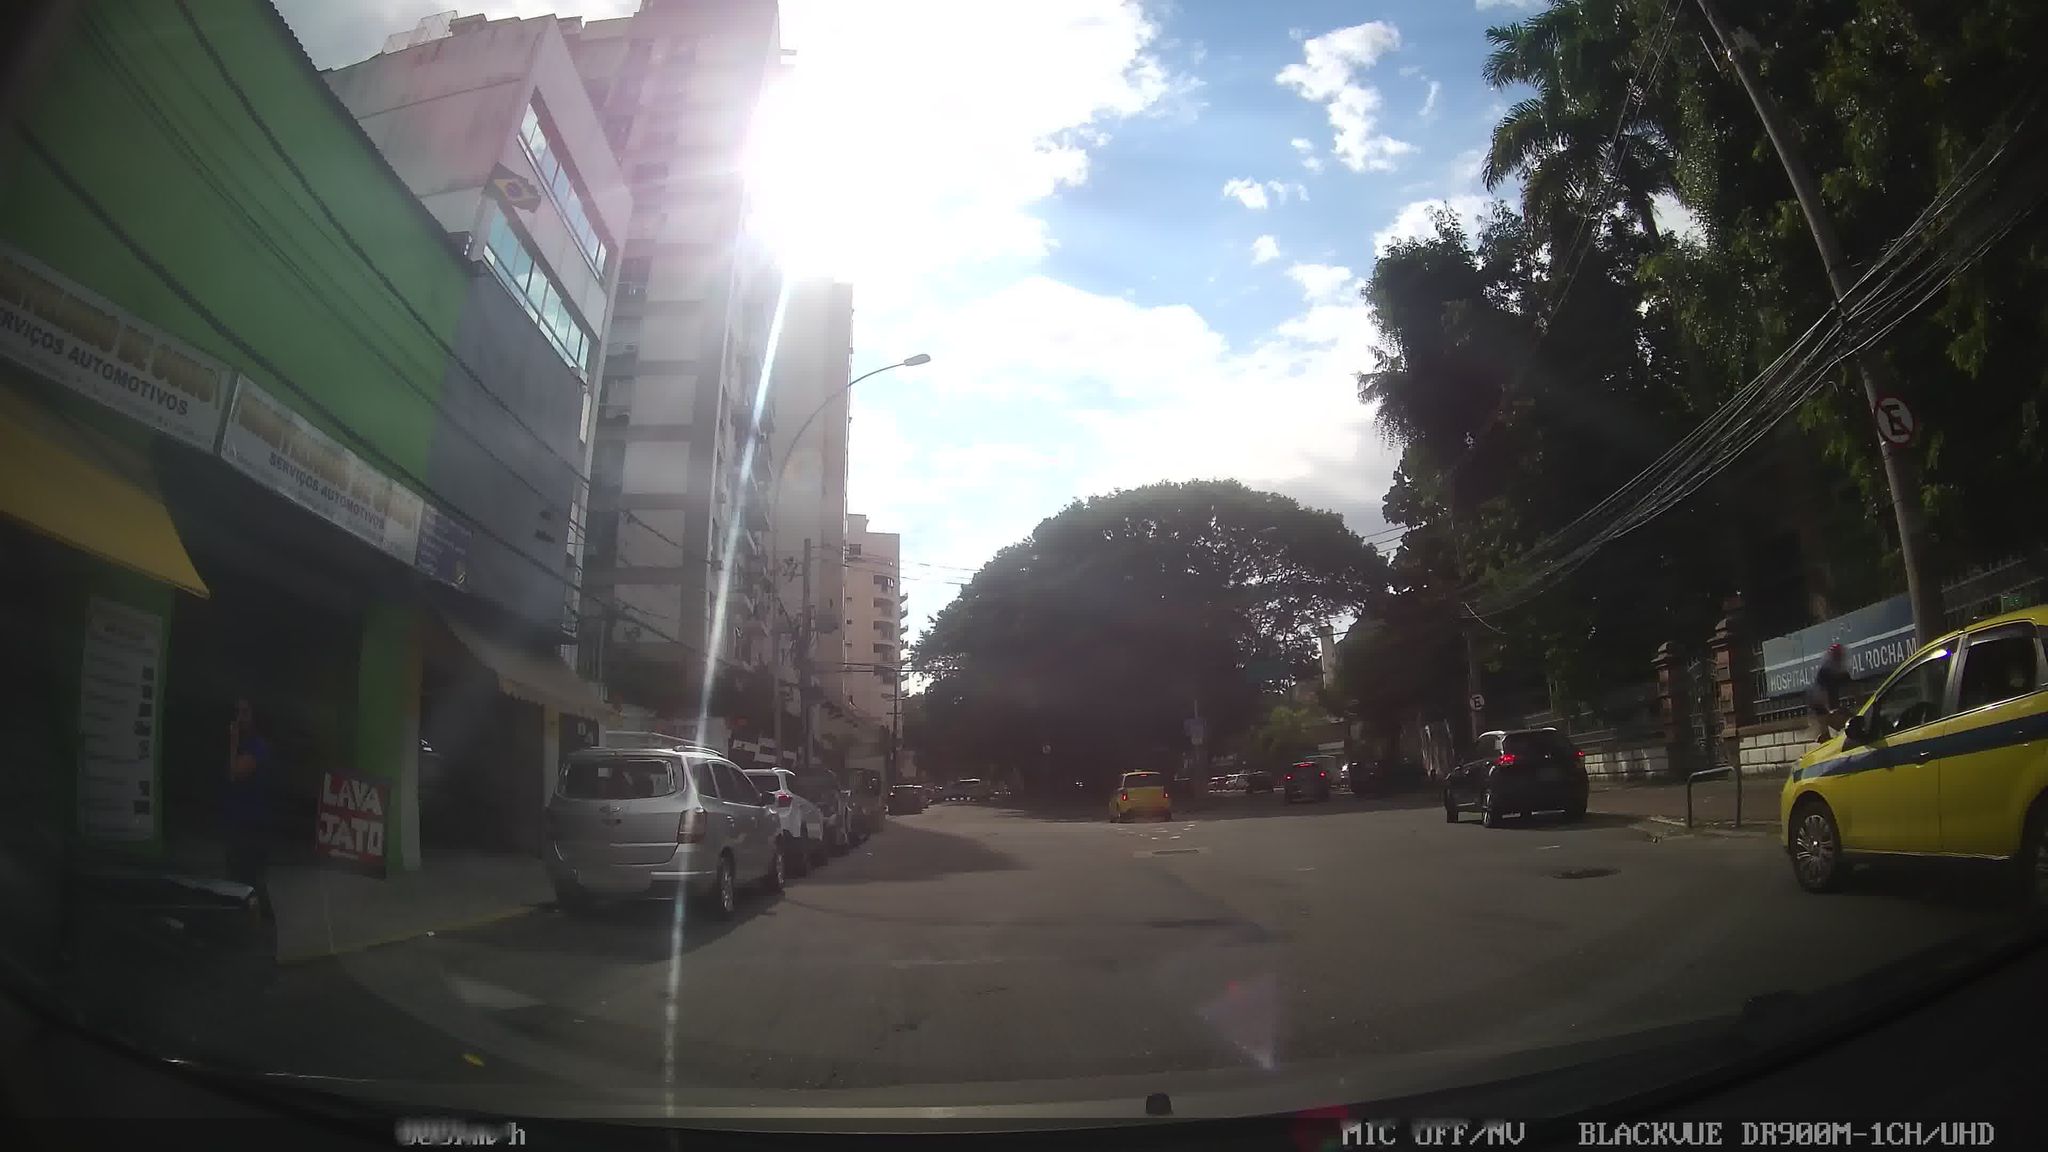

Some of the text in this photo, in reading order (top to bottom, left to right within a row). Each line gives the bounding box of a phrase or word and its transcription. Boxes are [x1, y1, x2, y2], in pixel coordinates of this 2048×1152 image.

[68, 345, 188, 415] AUTOMOTIVOS
[268, 450, 386, 531] SERVIÇOS AUTOMOTIVOS
[1770, 669, 1809, 691] HOSPITAL
[1865, 641, 1905, 670] ROCHA
[322, 772, 383, 816] LAVA
[319, 813, 384, 856] JATO
